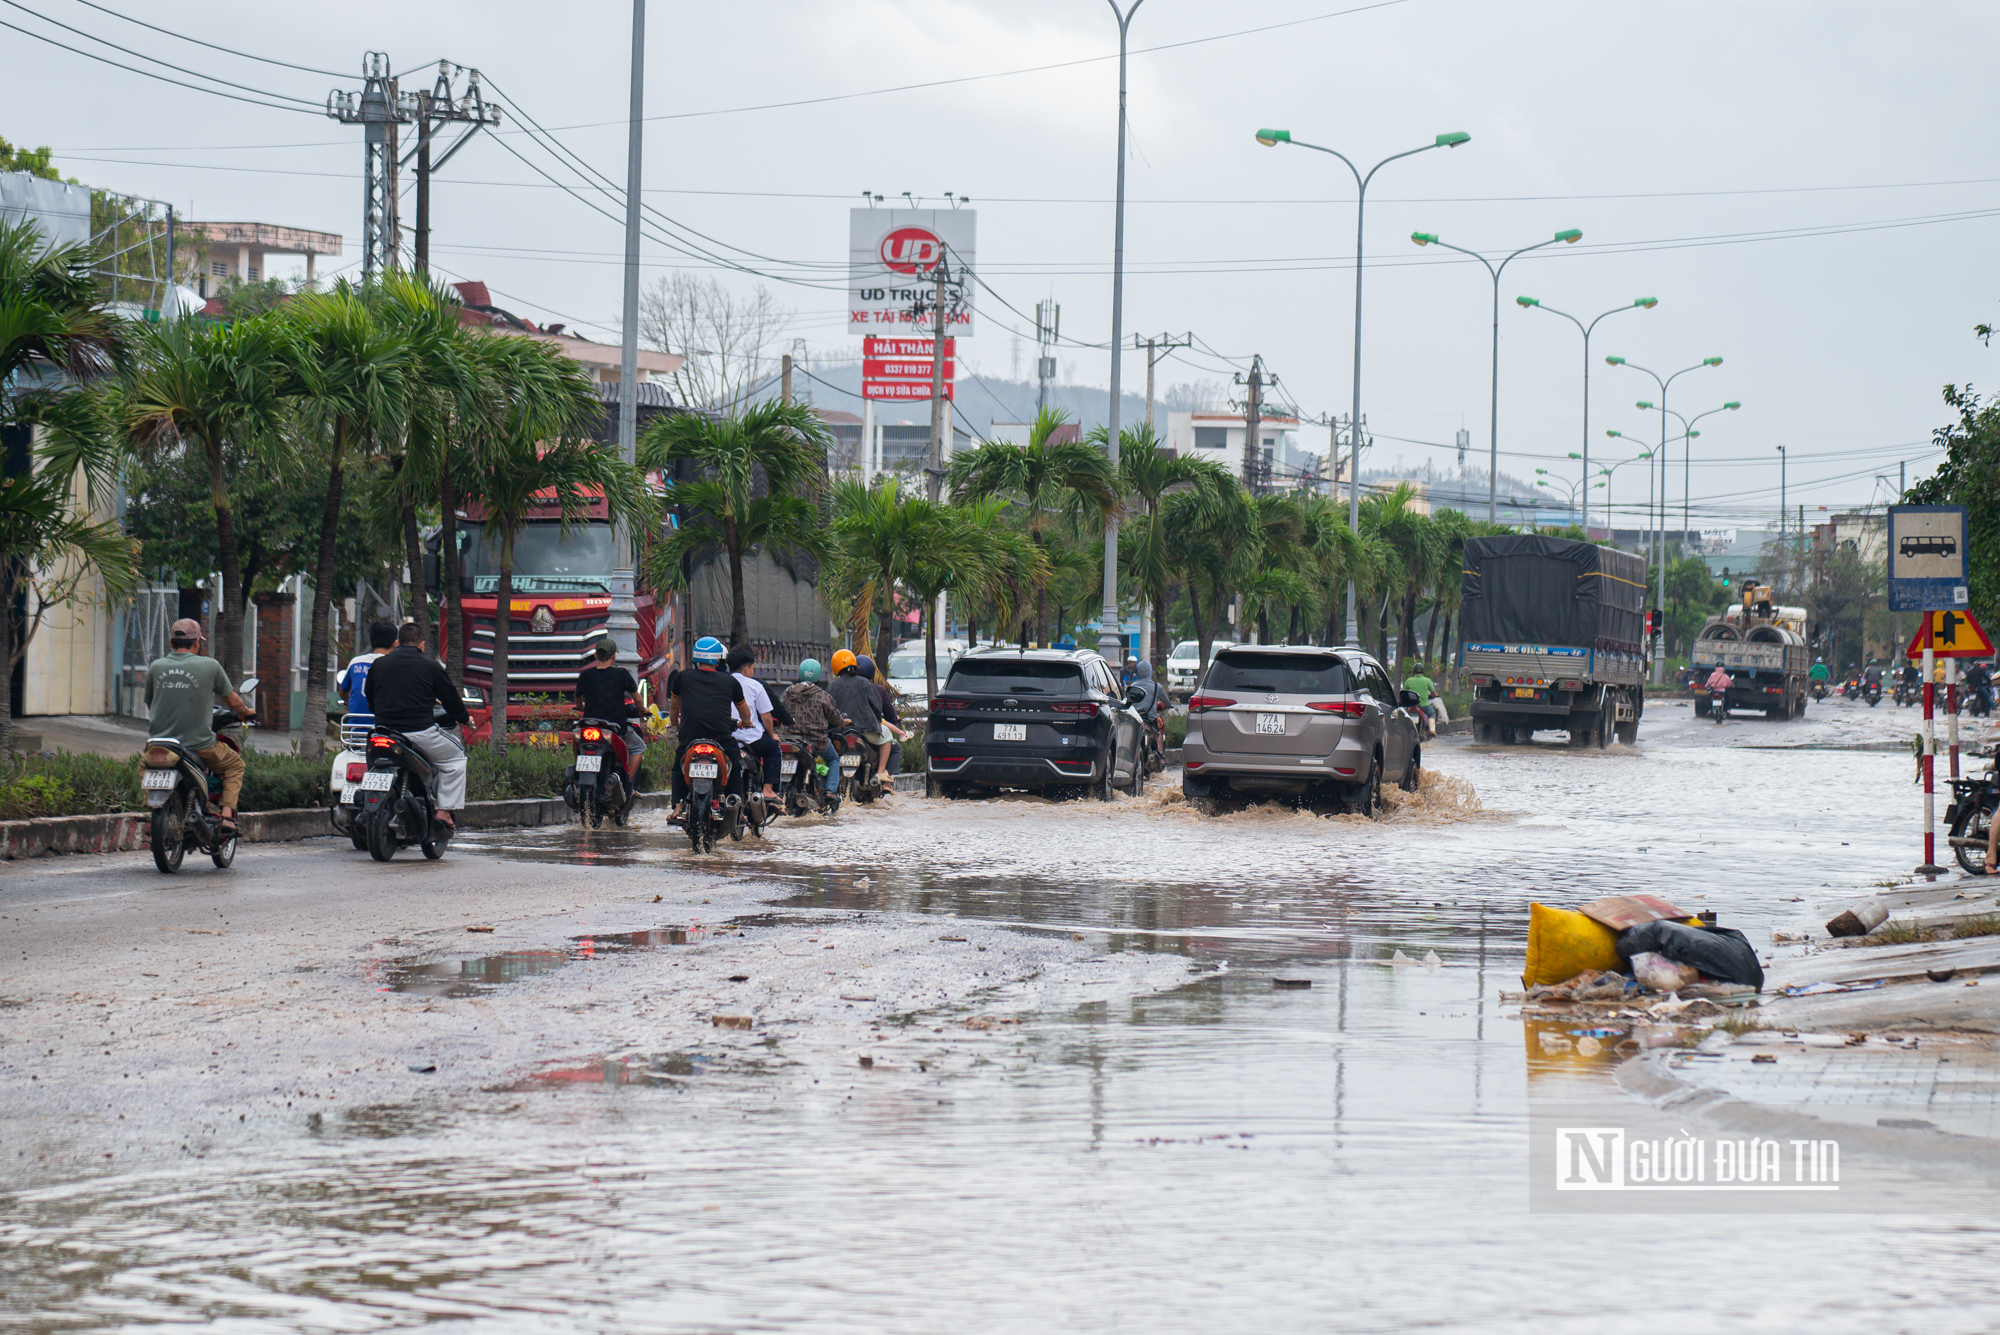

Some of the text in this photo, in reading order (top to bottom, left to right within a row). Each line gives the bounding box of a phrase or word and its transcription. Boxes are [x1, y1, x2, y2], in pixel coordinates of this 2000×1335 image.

[882, 240, 940, 263] UD
[860, 289, 885, 300] UD
[851, 312, 868, 323] XE
[874, 308, 894, 323] TẢI
[874, 340, 934, 354] HẢI THÀN
[885, 364, 931, 374] 0337 919 377
[867, 385, 884, 396] DỊCH
[885, 386, 895, 397] VỤ
[896, 384, 910, 395] SỮA
[912, 384, 931, 396] CHỮA
[476, 578, 498, 590] VT
[1263, 714, 1278, 724] 77A
[1257, 724, 1284, 733] 146.24
[147, 780, 170, 788] 6990
